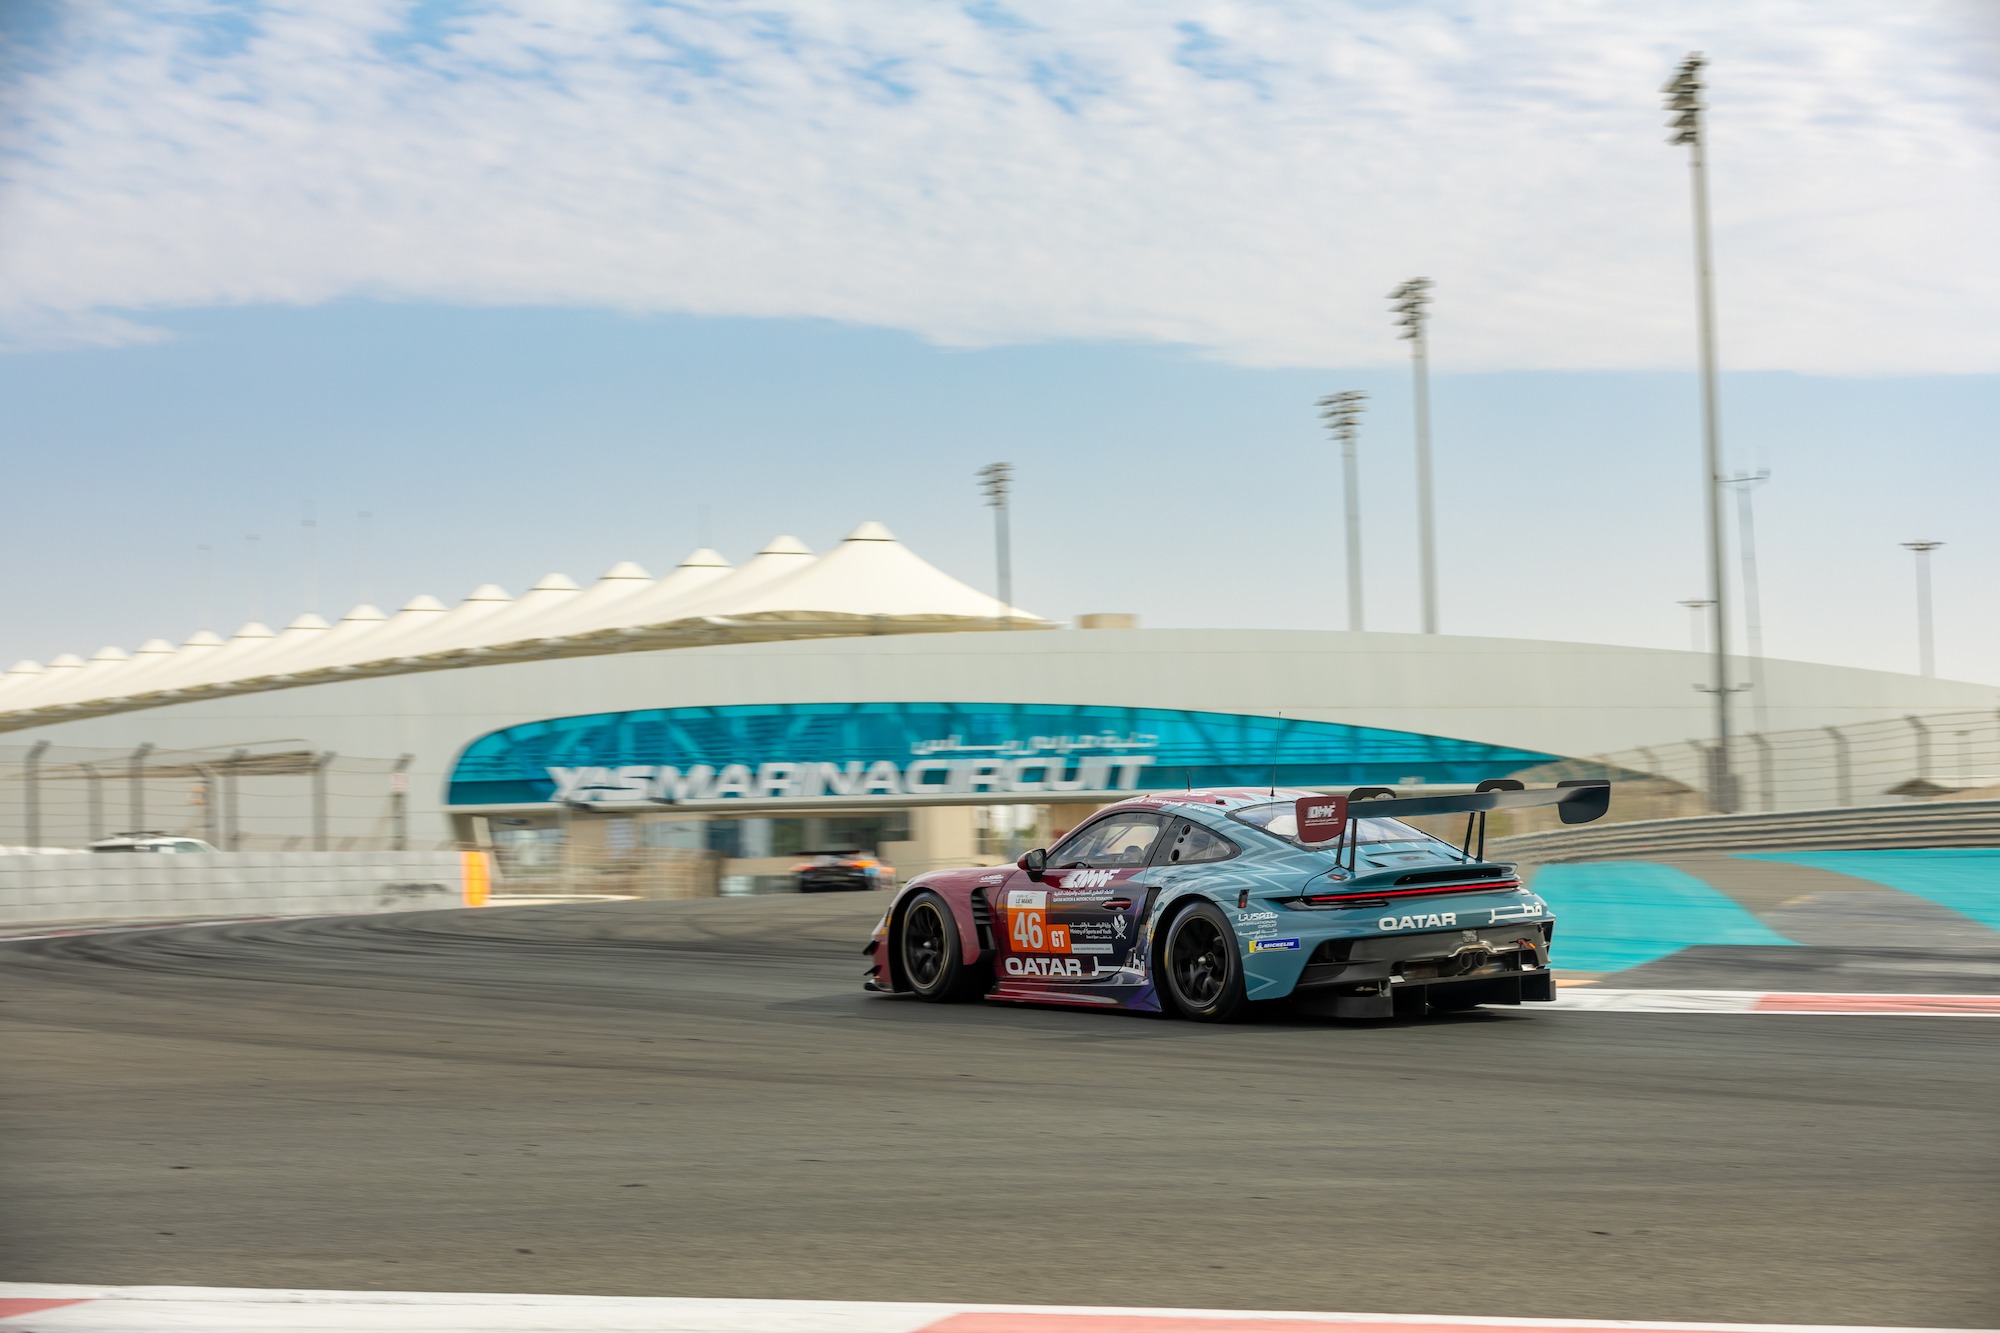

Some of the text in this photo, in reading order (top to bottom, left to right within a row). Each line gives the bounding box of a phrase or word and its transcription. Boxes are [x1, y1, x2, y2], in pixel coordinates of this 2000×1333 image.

[545, 755, 1157, 801] YAS MARINA CIRCUIT
[1378, 912, 1457, 931] QATAR
[1488, 902, 1543, 924] قطر
[1013, 911, 1043, 949] 46
[1051, 930, 1065, 948] GT
[1005, 957, 1082, 977] QATAR
[1091, 953, 1146, 977] قطر
